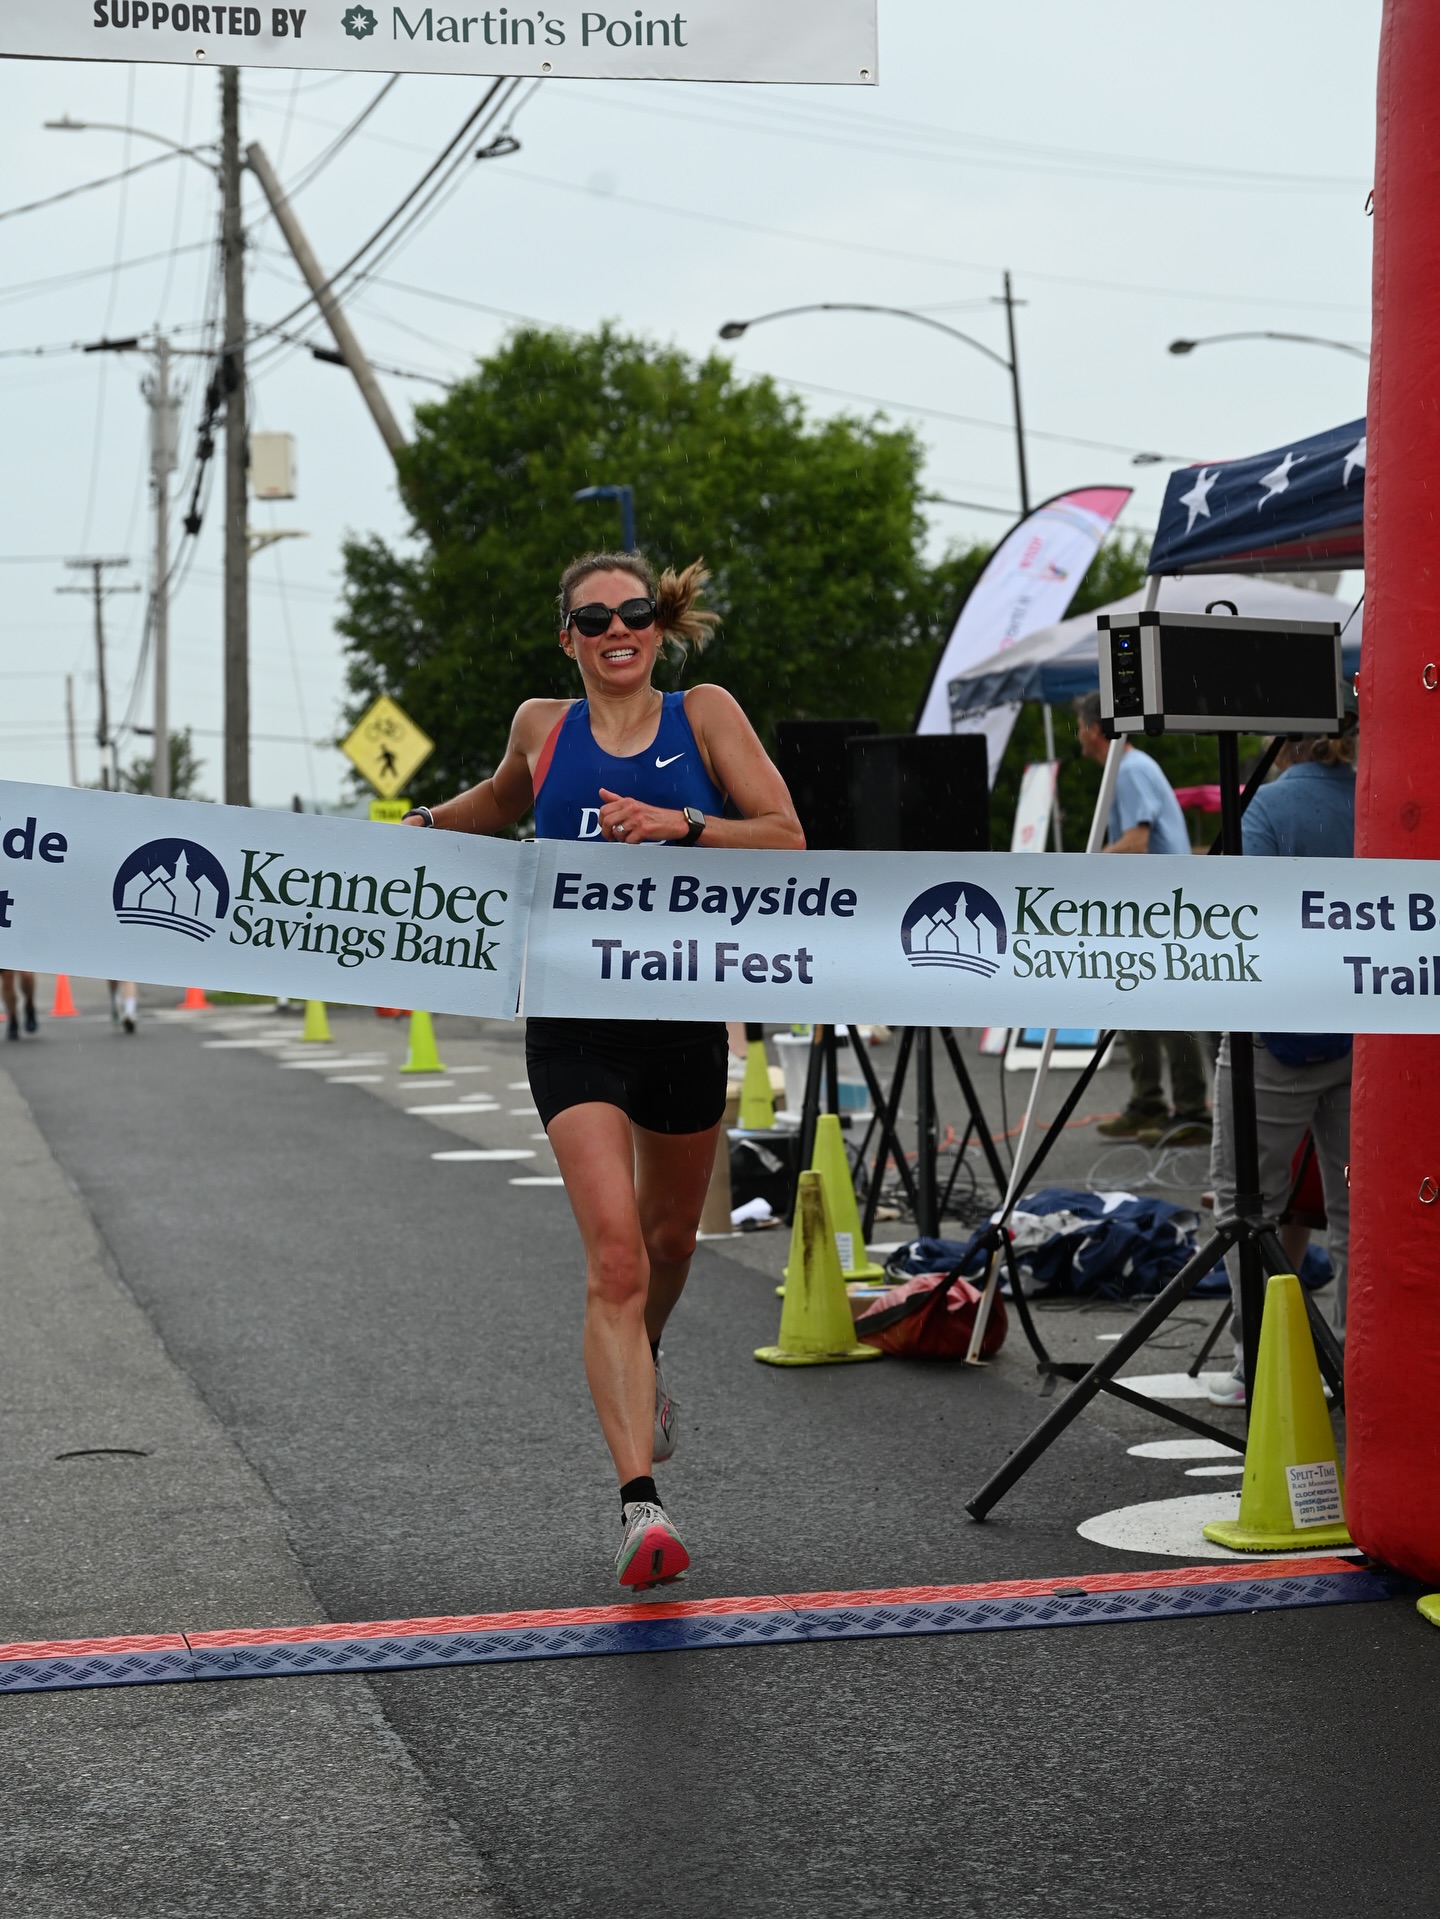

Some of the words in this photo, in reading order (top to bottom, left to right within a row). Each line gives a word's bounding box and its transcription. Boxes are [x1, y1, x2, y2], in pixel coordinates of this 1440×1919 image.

[93, 0, 261, 36] SUPPORTED
[271, 8, 307, 39] BY
[392, 7, 566, 46] Martin's
[581, 10, 688, 47] Point
[0, 816, 68, 863] de
[235, 849, 507, 927] Kennebec
[553, 872, 657, 912] East
[668, 875, 858, 926] Bayside
[1301, 890, 1395, 931] East
[1408, 893, 1440, 931] B
[1011, 886, 1259, 941] Kennebec
[230, 904, 386, 968] Savings
[391, 921, 501, 972] Bank
[592, 938, 698, 982] Trail
[714, 942, 814, 985] Fest
[1012, 938, 1157, 992] Savings
[1160, 941, 1263, 983] Bank
[1343, 955, 1440, 996] Trail
[1295, 1490, 1316, 1498] CLOCK
